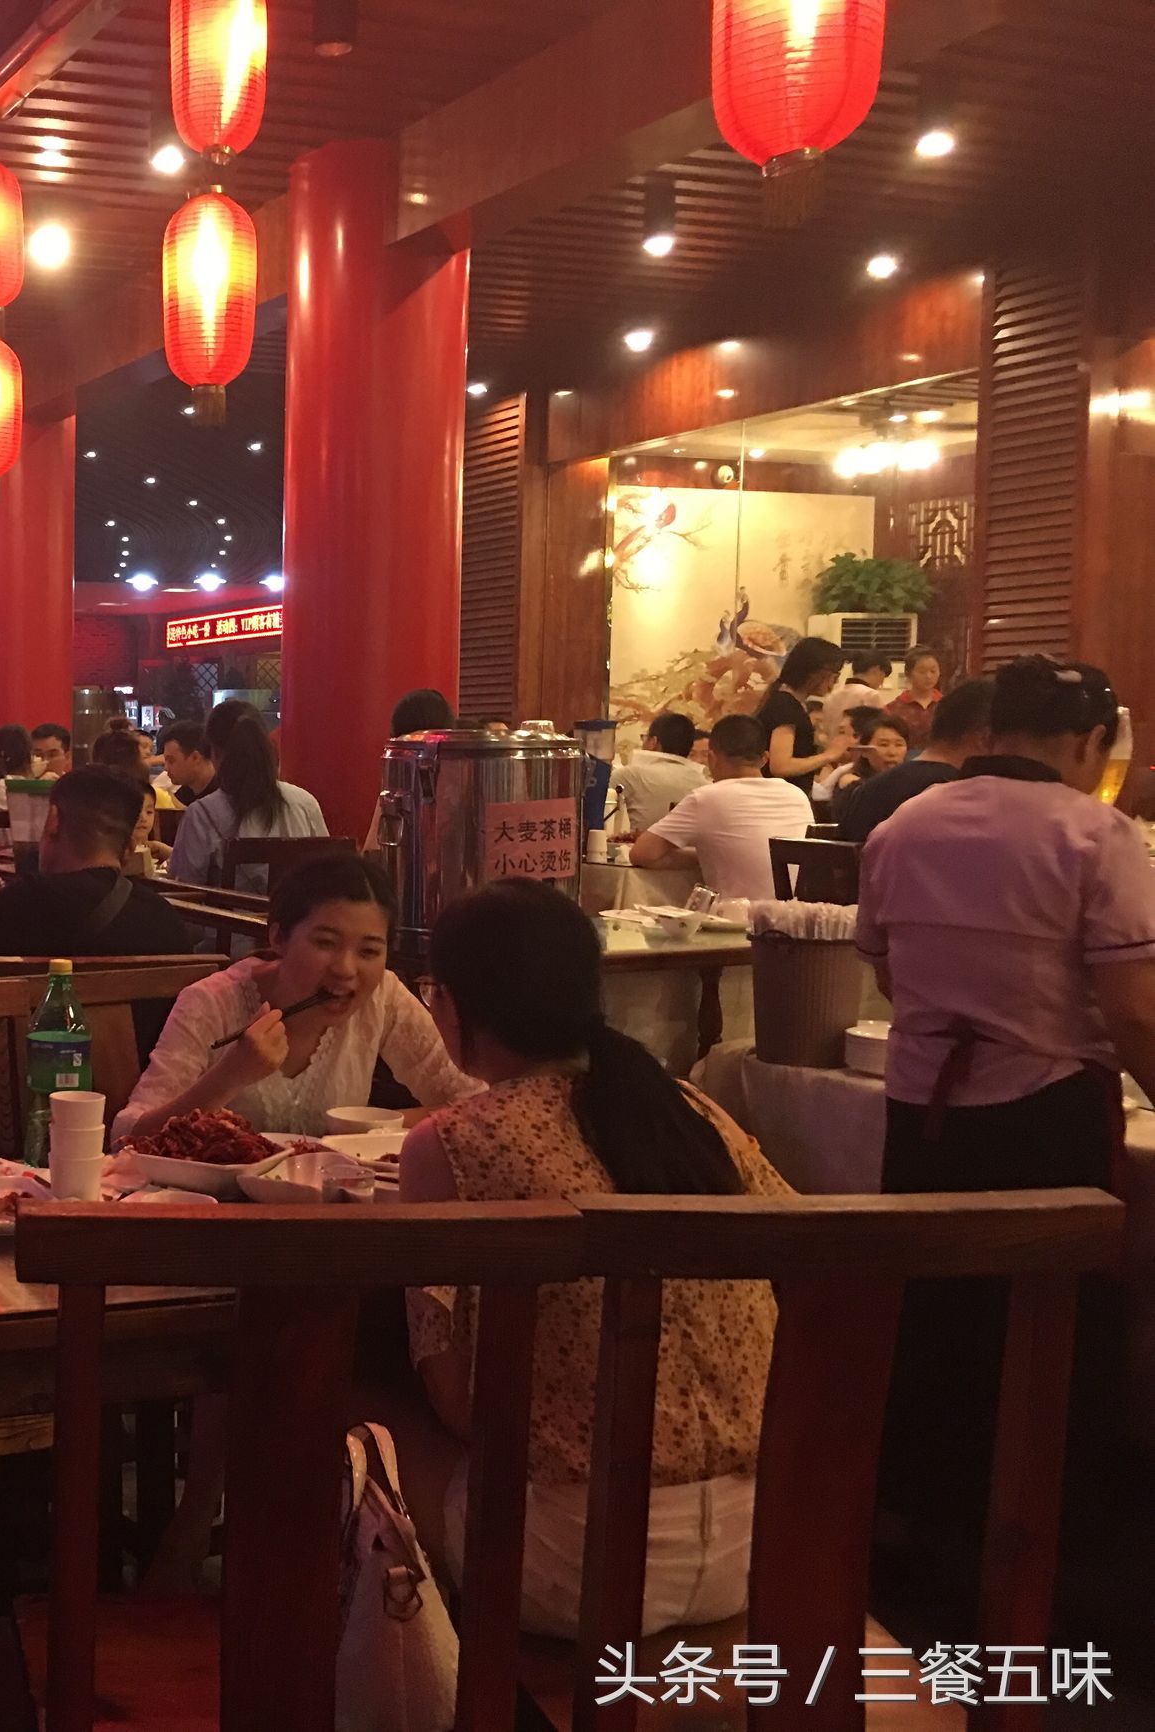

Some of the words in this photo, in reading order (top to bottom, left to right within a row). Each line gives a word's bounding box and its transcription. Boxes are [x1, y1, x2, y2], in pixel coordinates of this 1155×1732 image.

[494, 818, 571, 843] 大麦茶桶
[494, 849, 571, 875] 小心烫伤
